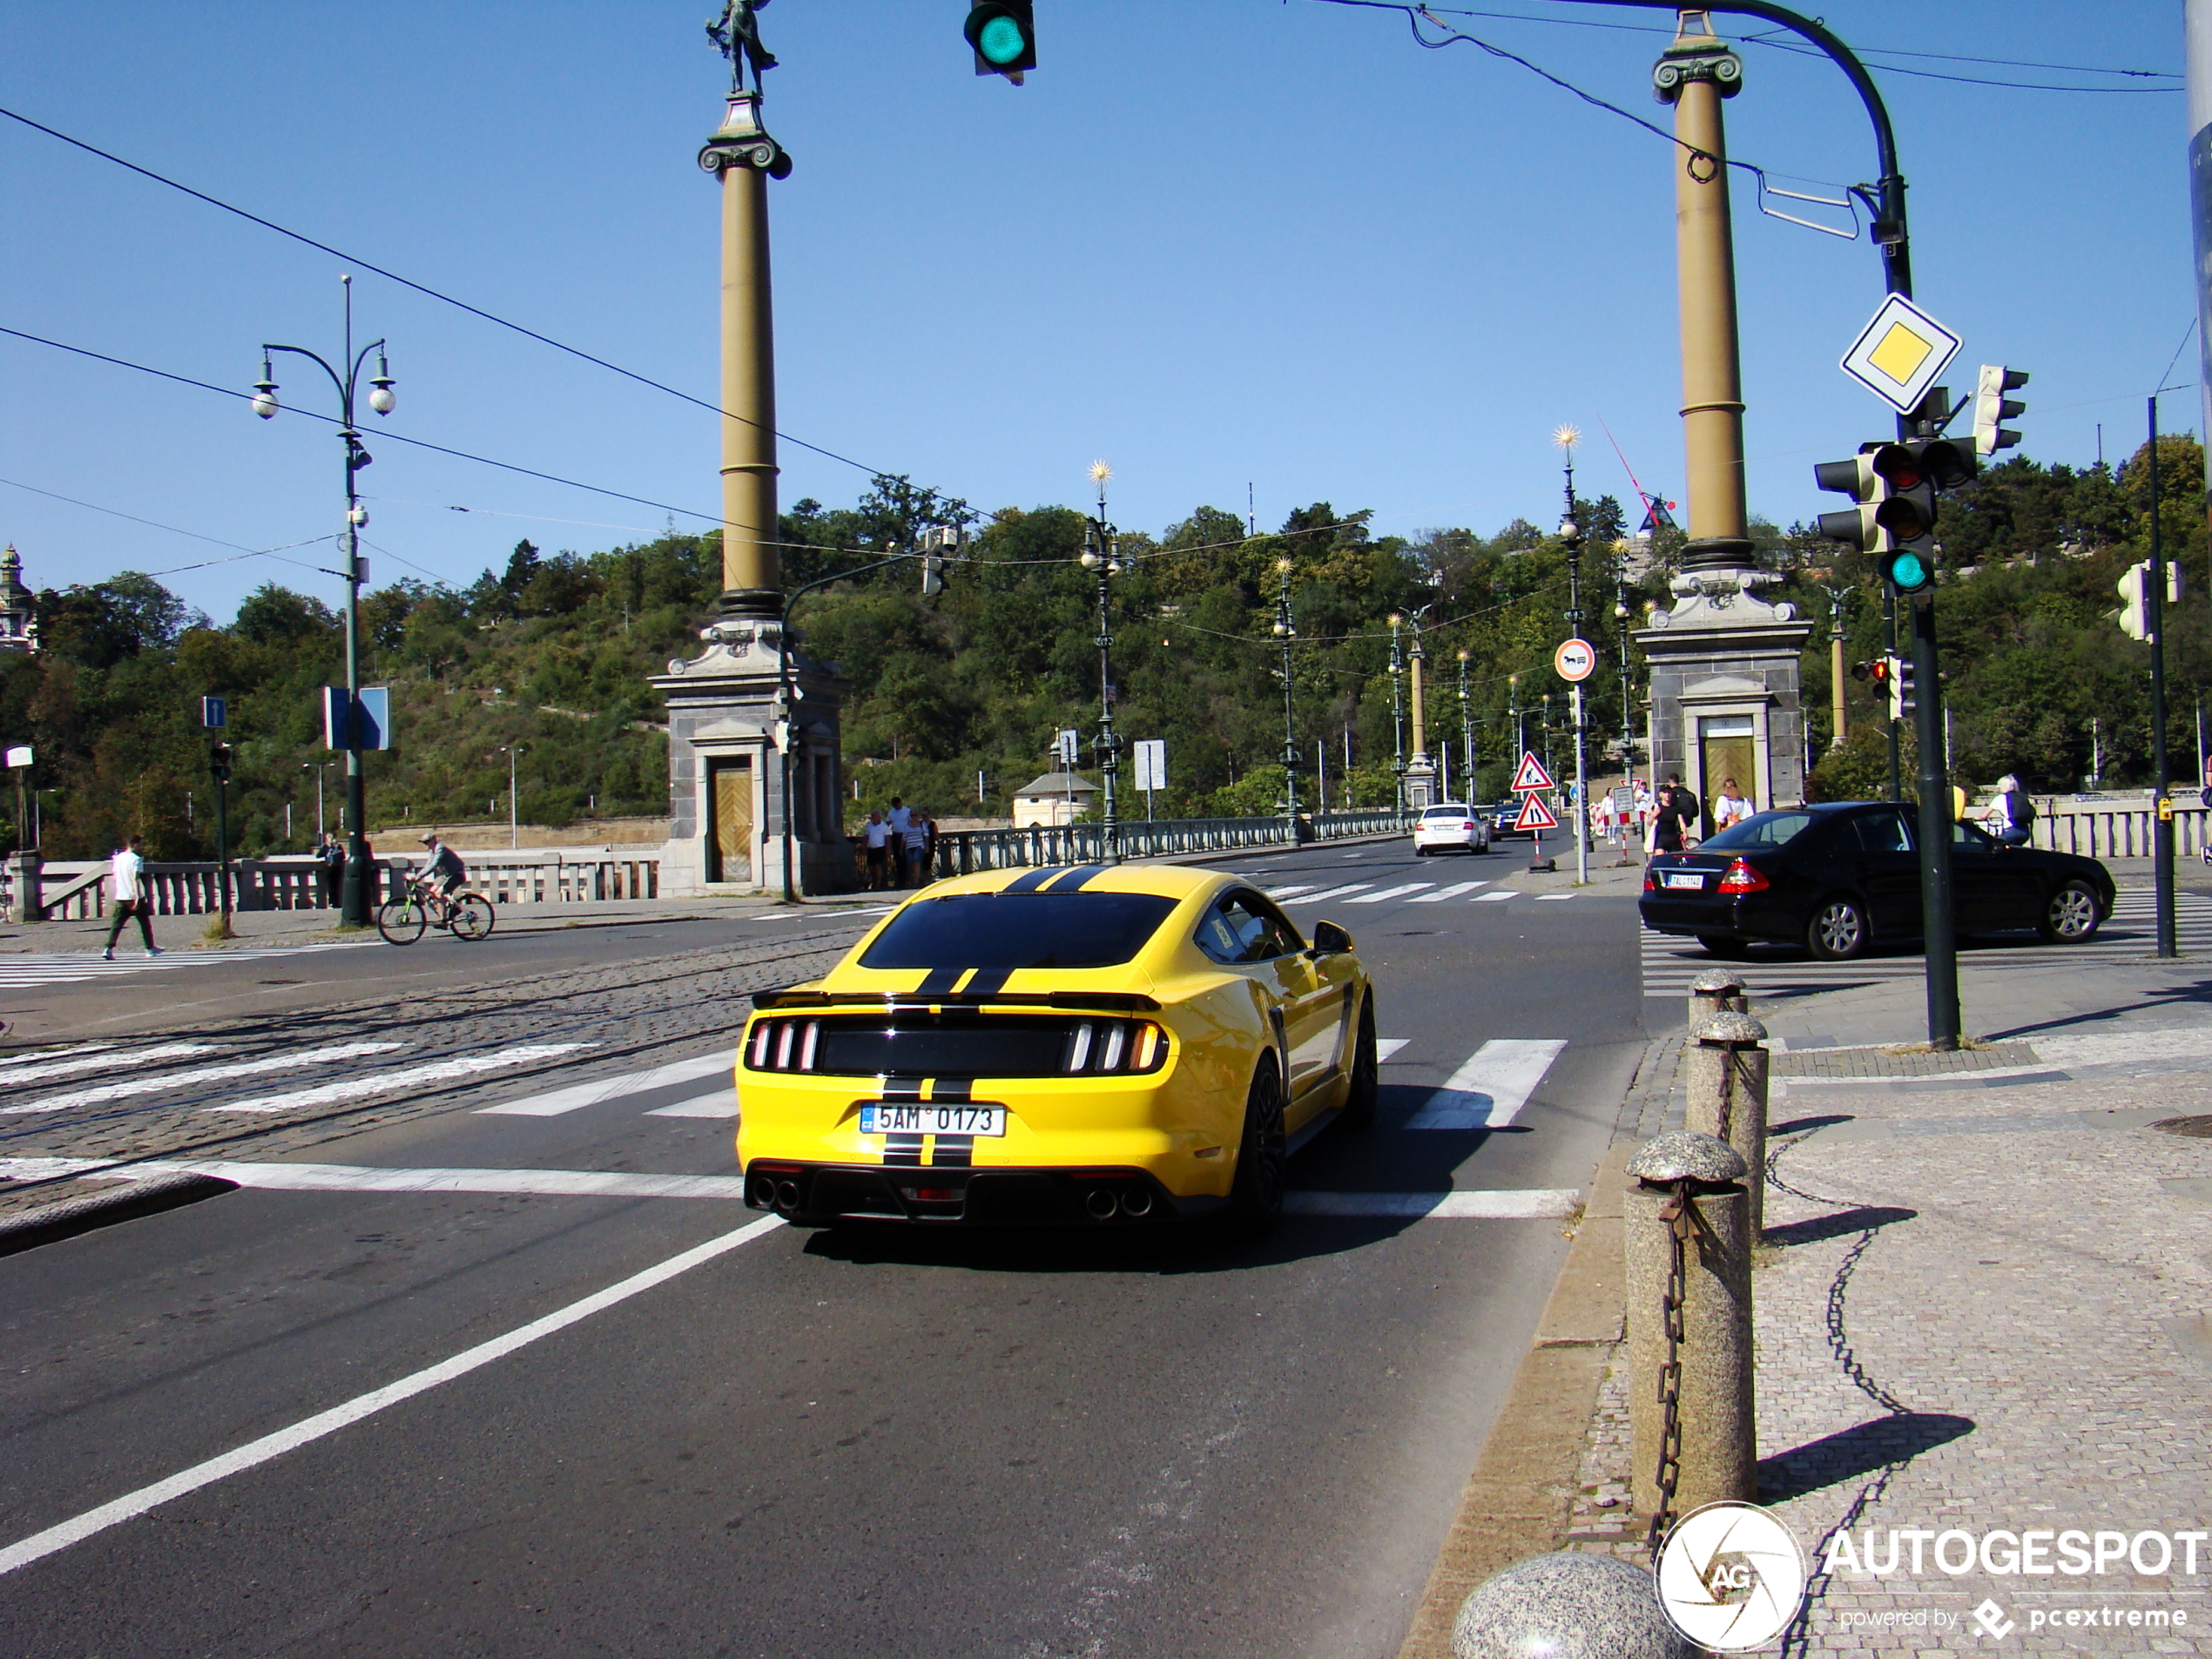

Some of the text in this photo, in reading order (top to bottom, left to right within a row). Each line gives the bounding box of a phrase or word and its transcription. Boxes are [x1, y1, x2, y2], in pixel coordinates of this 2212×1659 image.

[1886, 244, 1894, 256] B
[880, 1105, 993, 1131] 5AM 0173
